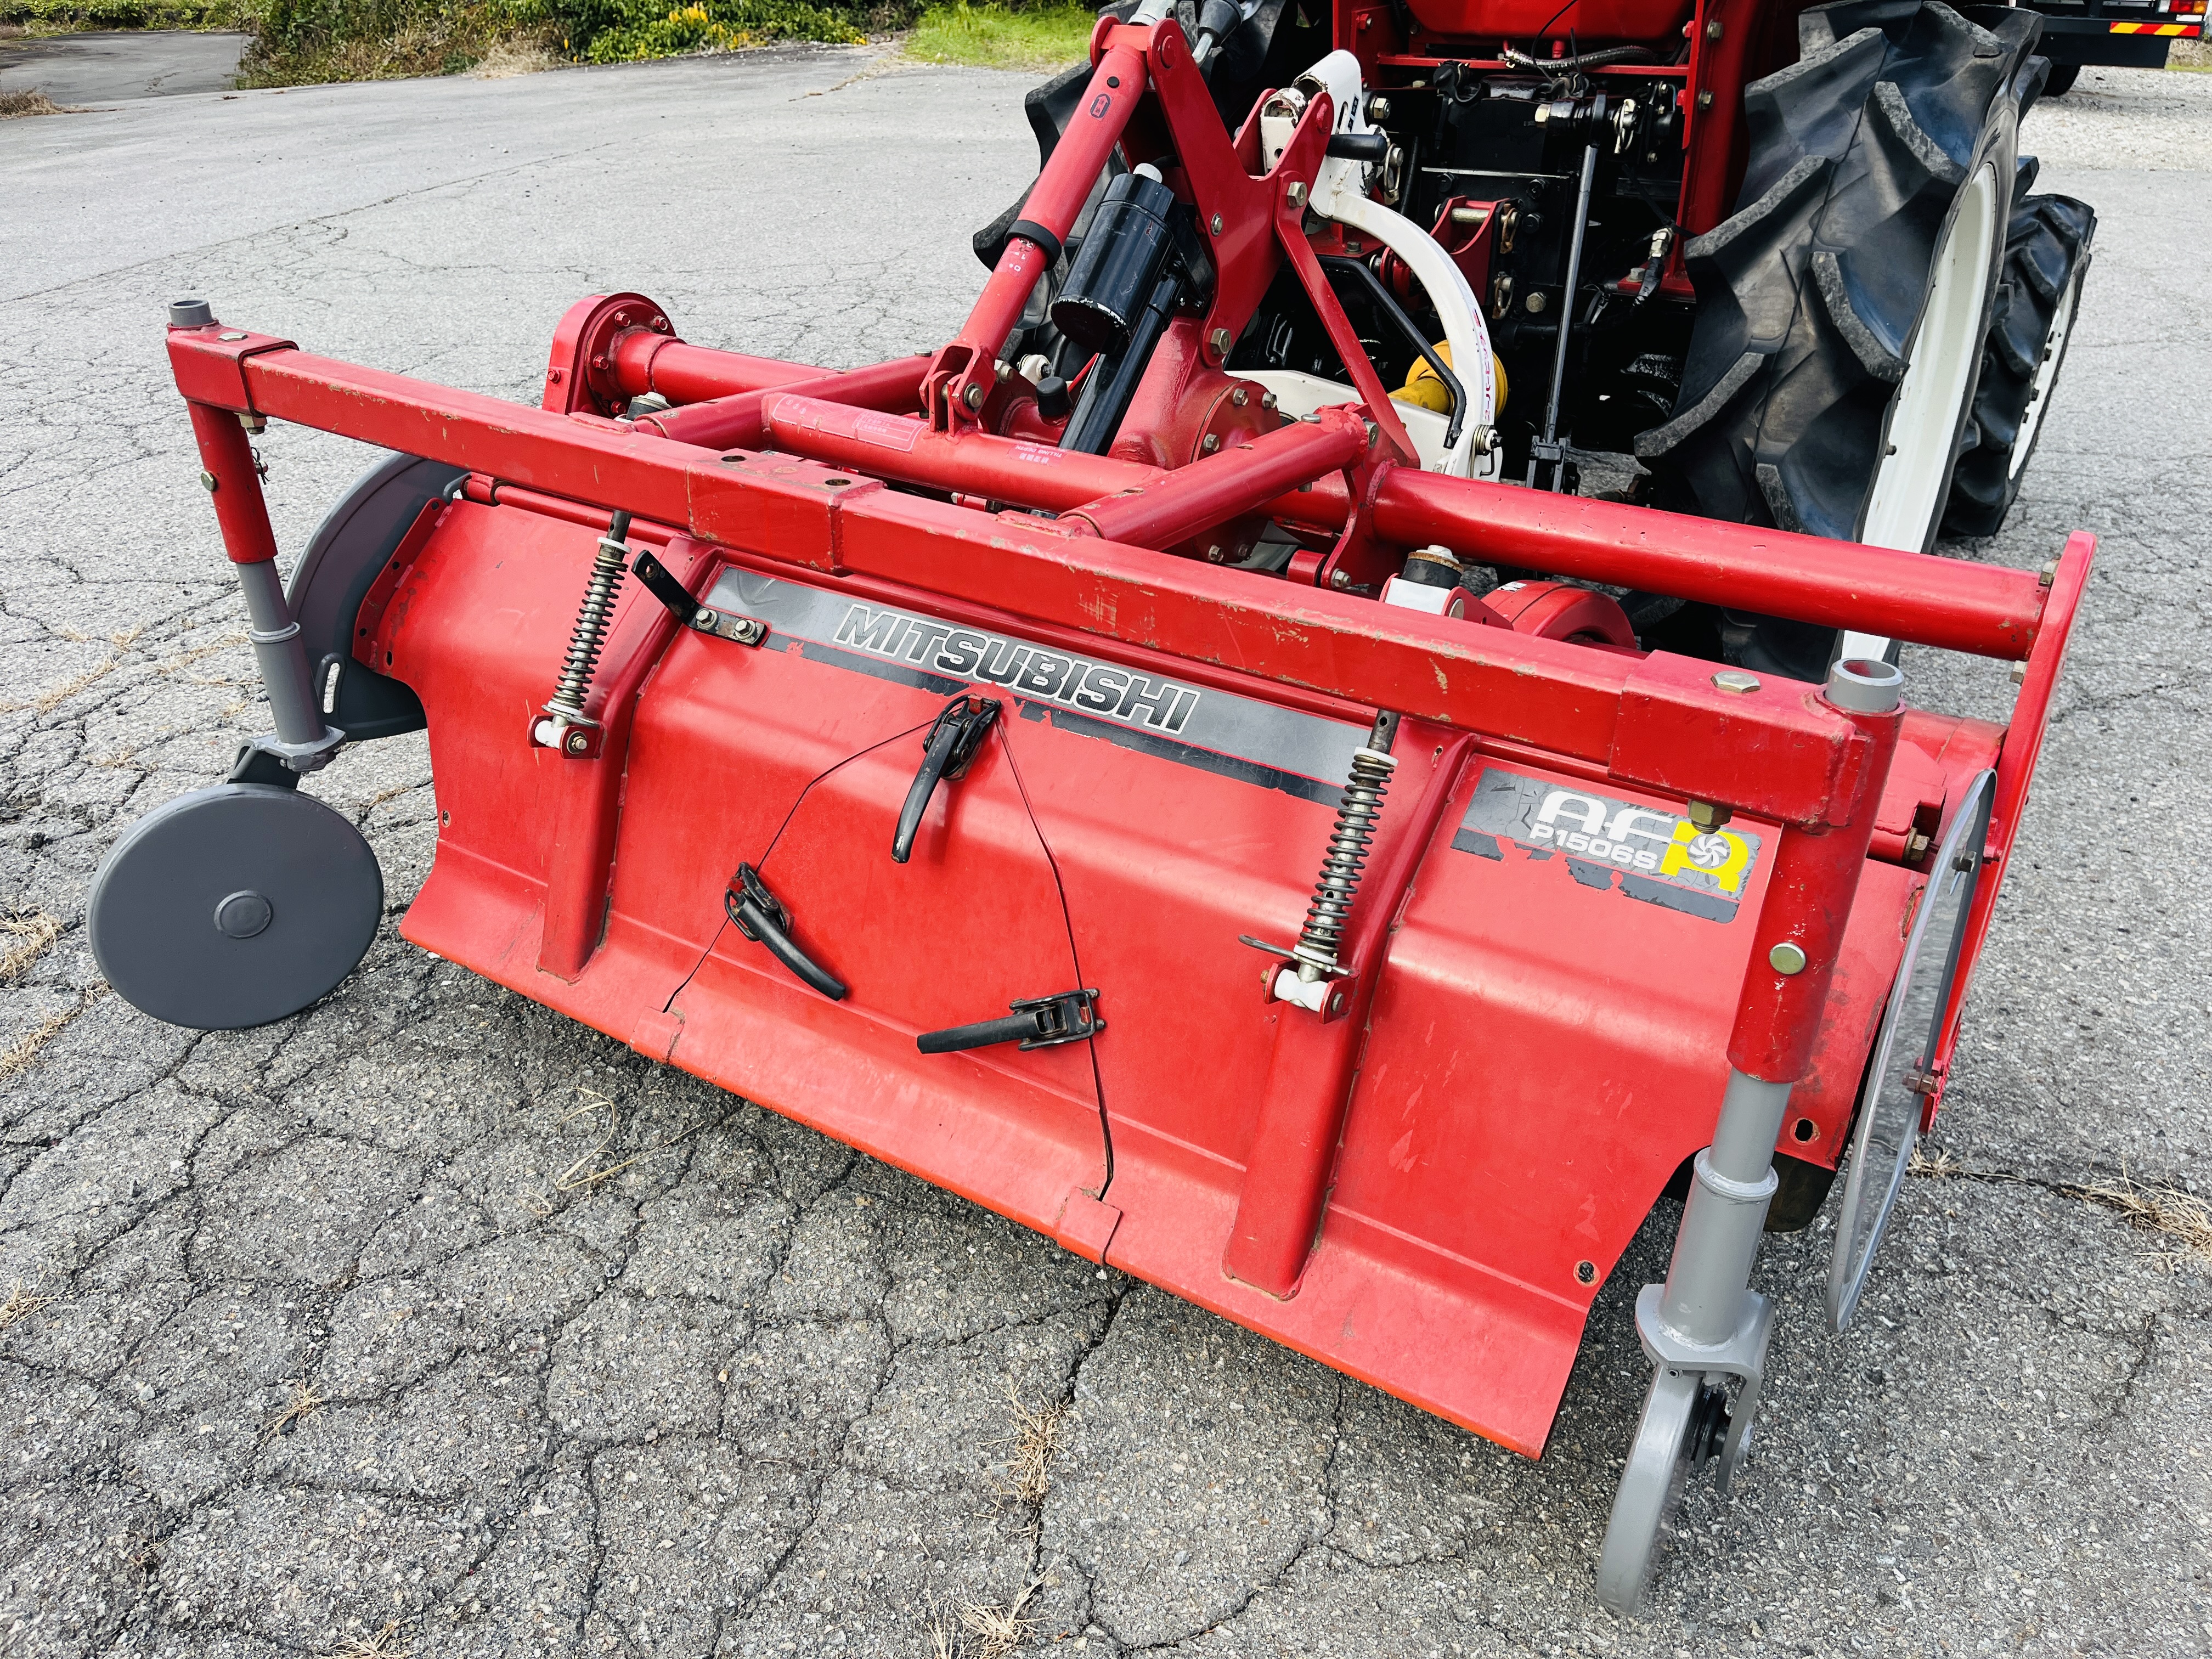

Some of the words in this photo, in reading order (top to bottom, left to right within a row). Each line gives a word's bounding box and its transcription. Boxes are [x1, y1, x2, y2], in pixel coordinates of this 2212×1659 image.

[1015, 445, 1037, 453] DEPTH
[1037, 449, 1063, 458] TILLING
[832, 603, 1201, 735] MITSUBISHI
[1529, 822, 1658, 870] P1506S
